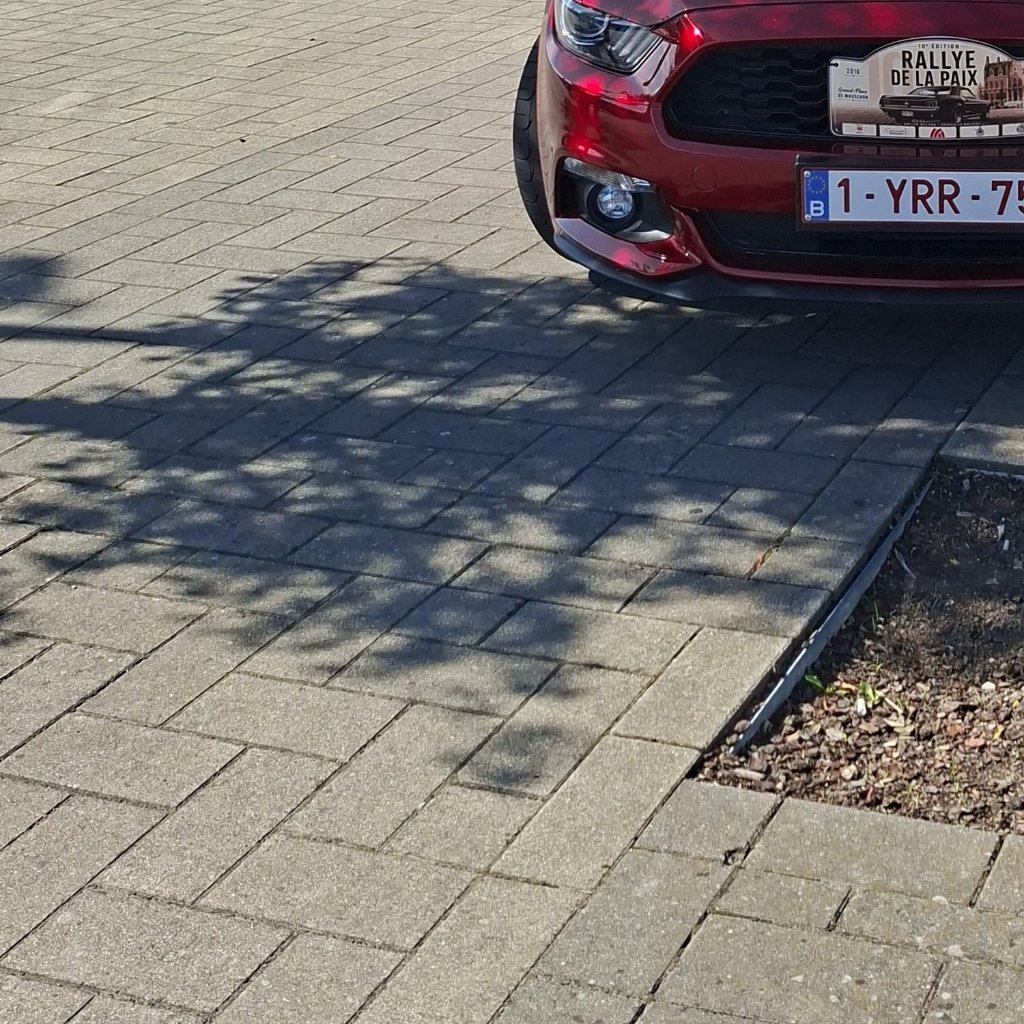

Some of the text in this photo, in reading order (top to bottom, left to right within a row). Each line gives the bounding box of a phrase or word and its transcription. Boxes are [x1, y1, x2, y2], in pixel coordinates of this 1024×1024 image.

[902, 50, 976, 69] RALLYE
[891, 69, 978, 86] DE LA PAIX
[810, 200, 825, 216] B
